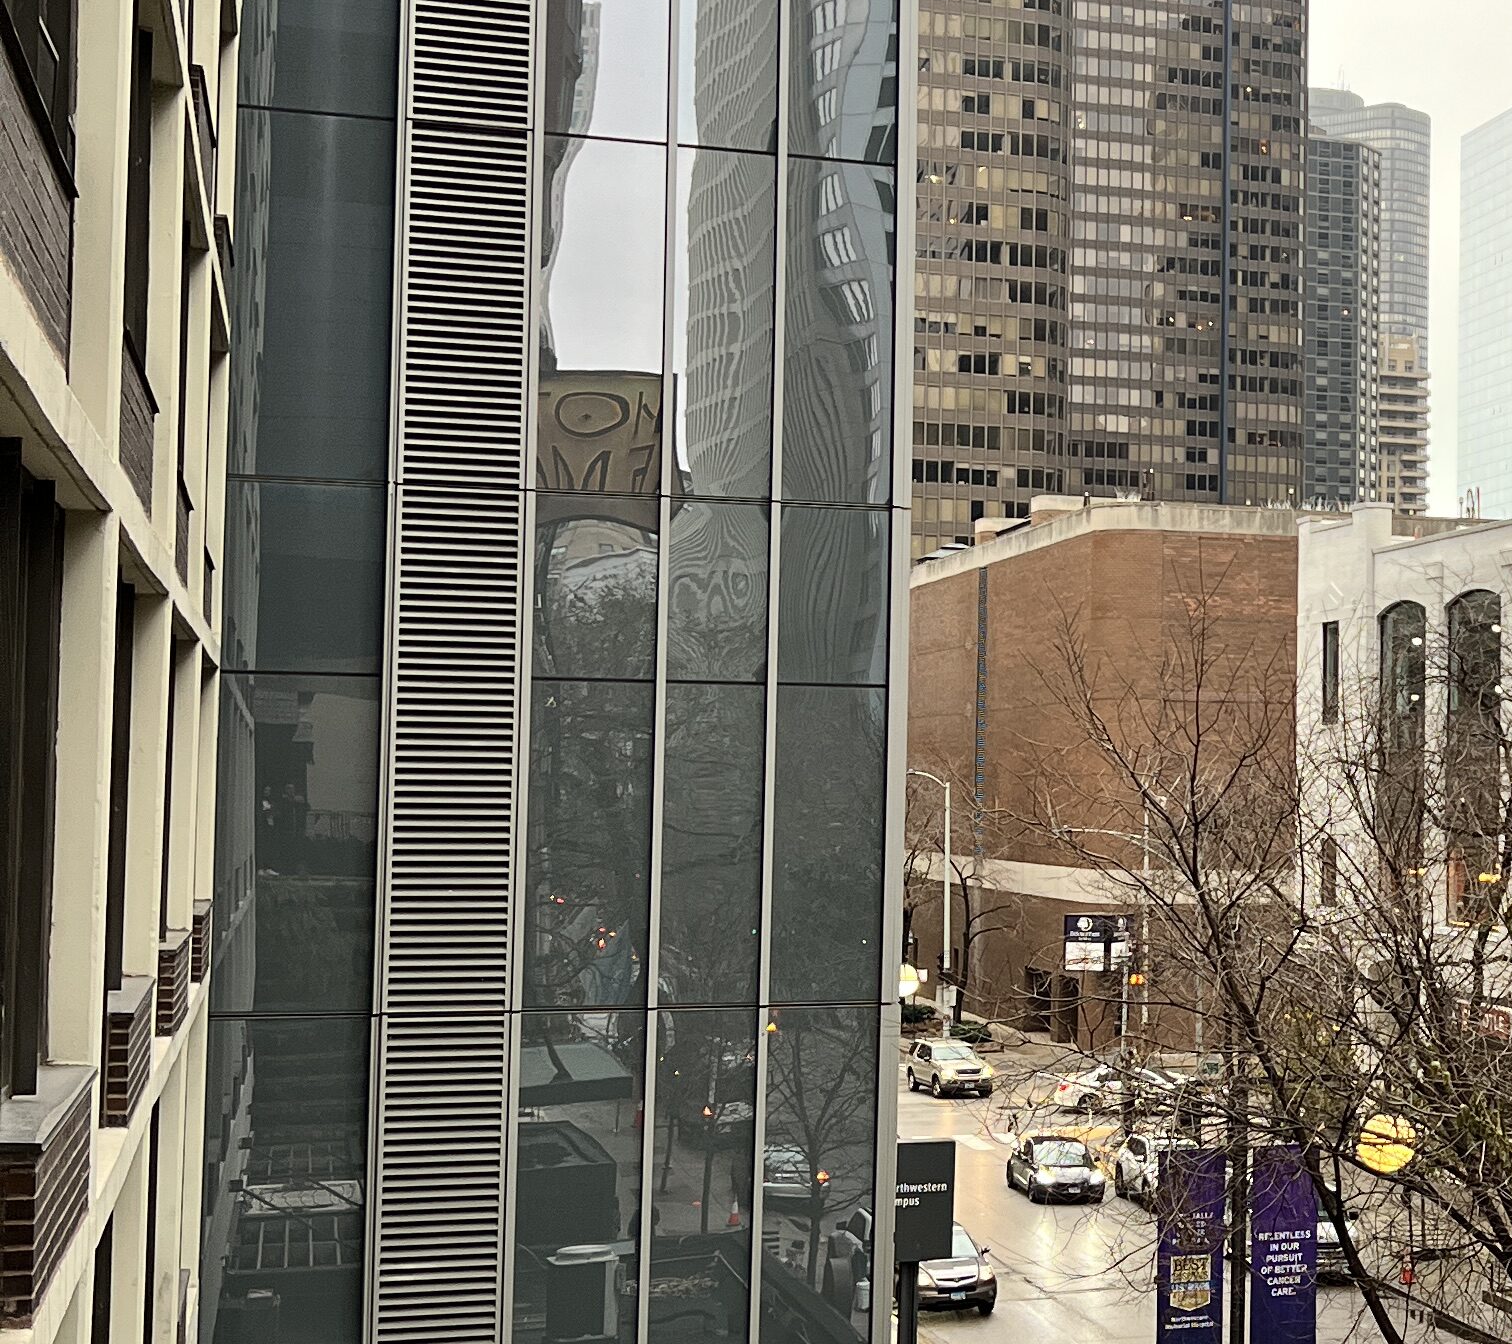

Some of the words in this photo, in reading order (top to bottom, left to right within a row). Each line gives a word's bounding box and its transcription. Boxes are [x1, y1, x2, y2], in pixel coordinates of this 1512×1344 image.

[895, 1182, 948, 1193] rthwestern
[894, 1197, 920, 1208] mpus
[1269, 1243, 1279, 1252] IN
[1281, 1242, 1300, 1251] OUR
[1265, 1253, 1303, 1263] PURSUIT
[1260, 1266, 1273, 1275] OF
[1274, 1264, 1308, 1274] BETTER
